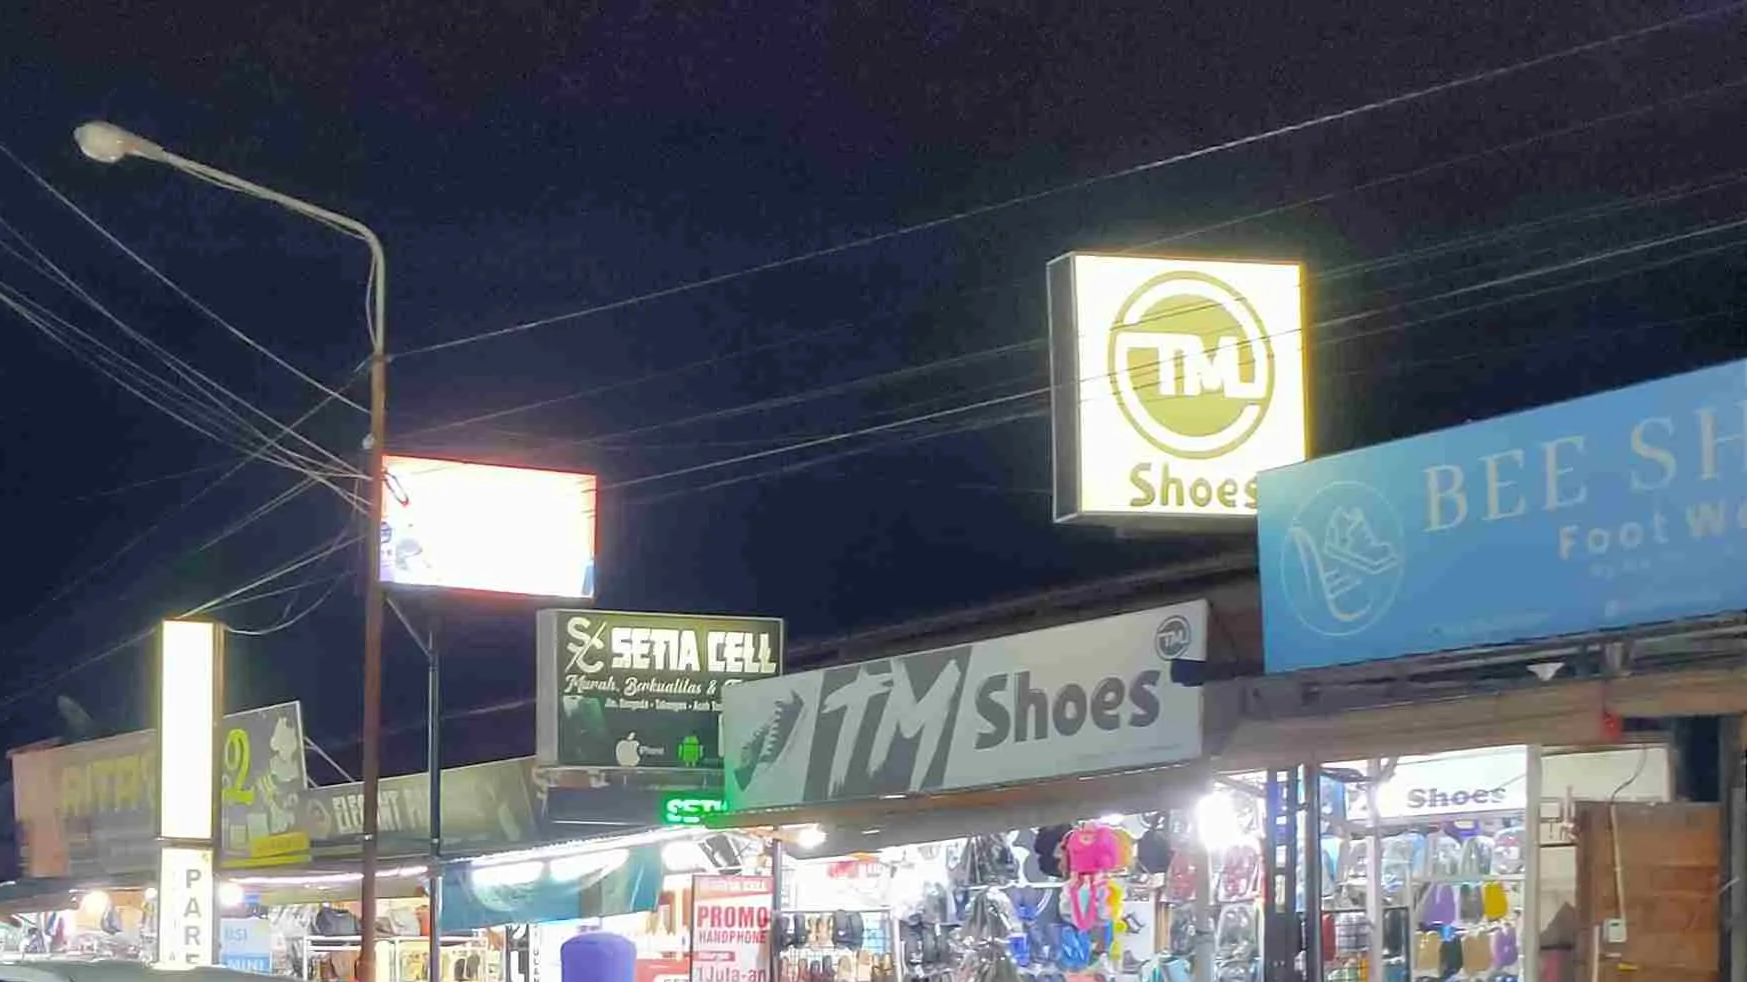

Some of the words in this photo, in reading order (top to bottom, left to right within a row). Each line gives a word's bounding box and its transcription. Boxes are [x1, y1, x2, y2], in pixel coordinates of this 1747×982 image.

[1422, 435, 1589, 533] BEE
[1559, 510, 1670, 560] Foot
[610, 626, 701, 672] SETIA
[707, 630, 777, 673] CELL
[823, 655, 962, 799] TM
[973, 669, 1163, 751] Shoes
[1406, 787, 1507, 809] Shoes
[697, 906, 768, 929] PROMO
[698, 929, 766, 945] HANDPHONE
